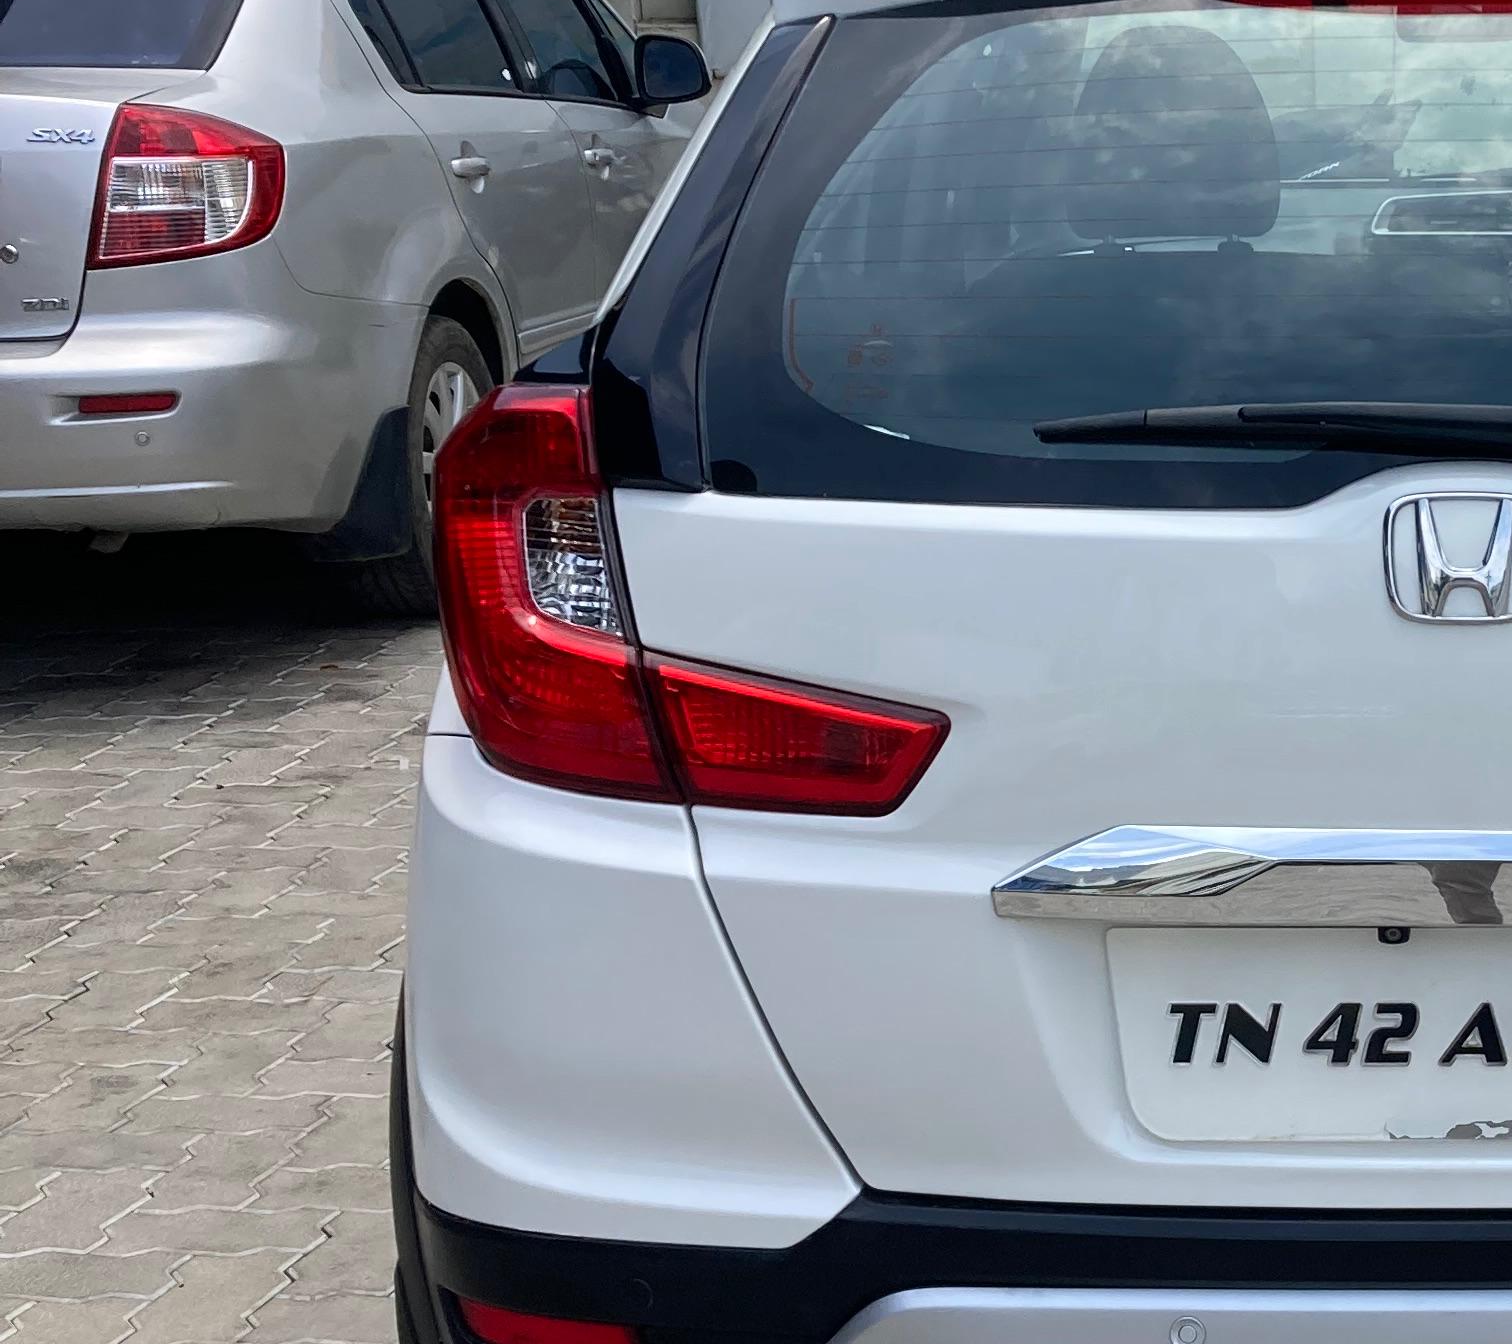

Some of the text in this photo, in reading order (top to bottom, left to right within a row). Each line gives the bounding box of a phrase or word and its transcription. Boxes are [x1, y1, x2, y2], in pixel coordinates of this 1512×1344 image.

[26, 127, 96, 145] SX4
[1167, 1000, 1283, 1067] TN
[1301, 1000, 1422, 1067] 42
